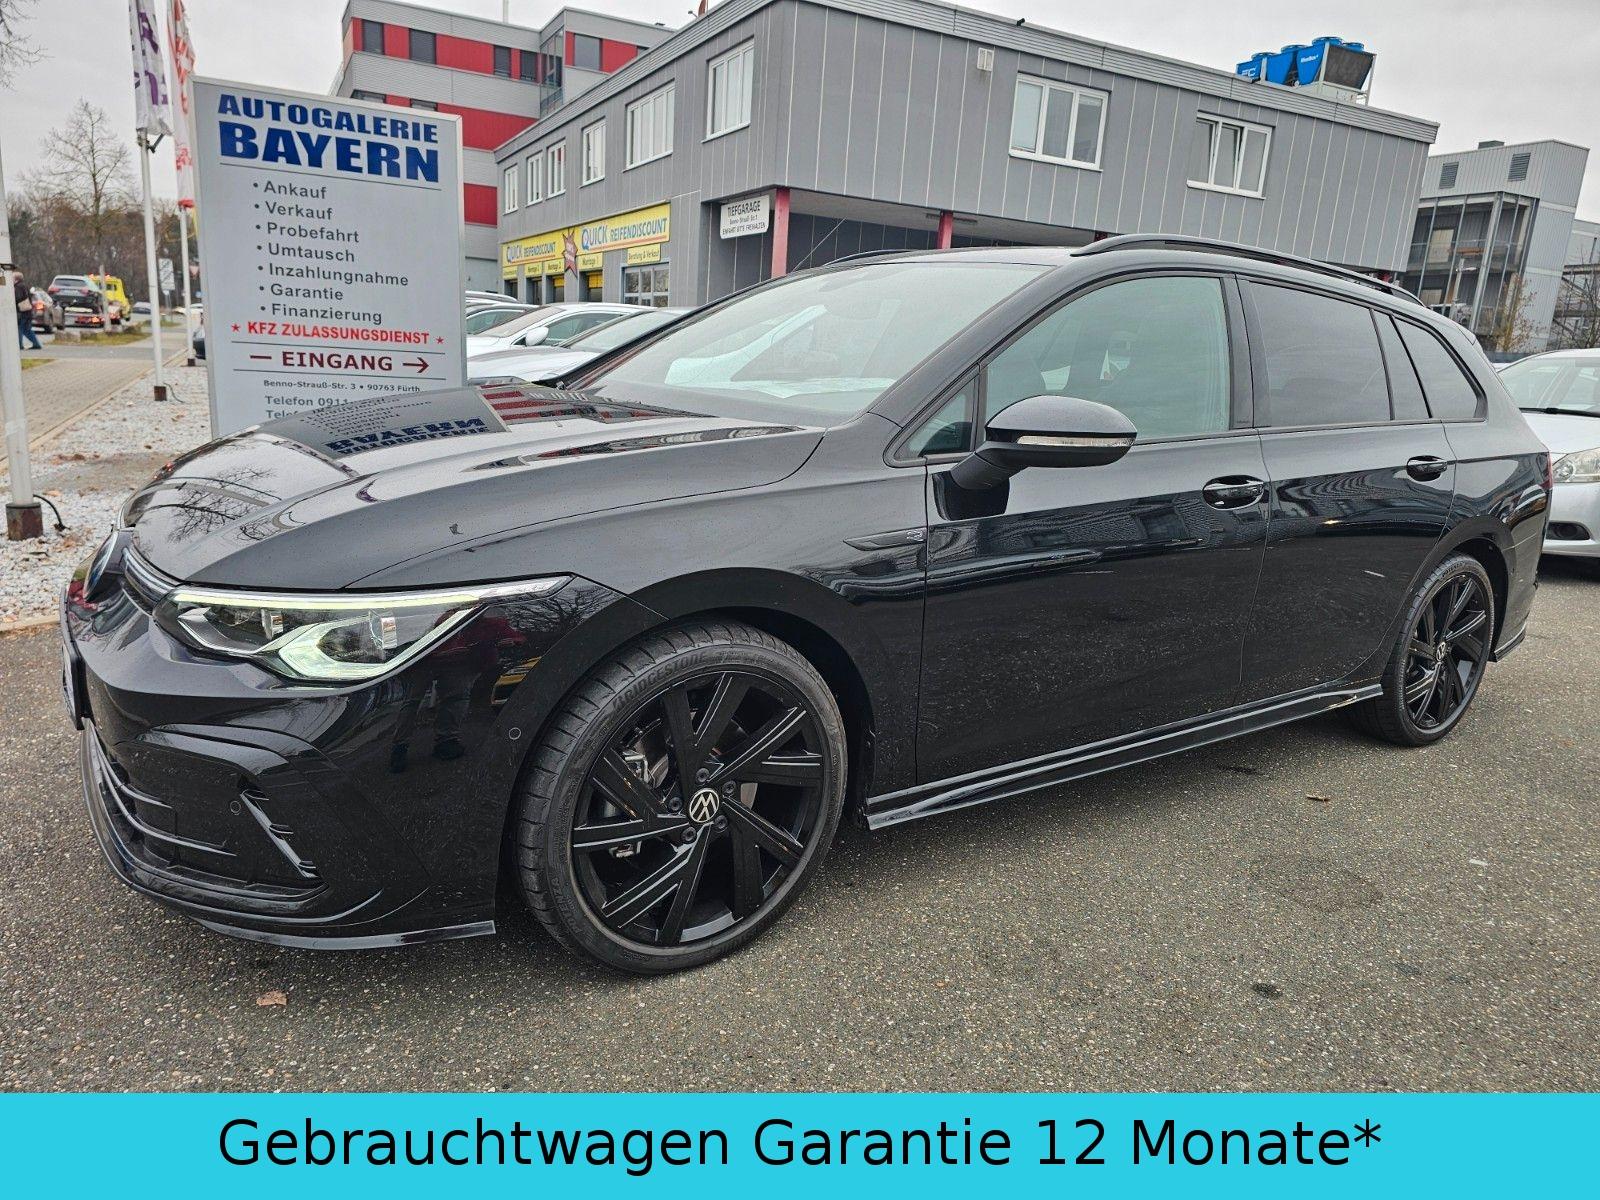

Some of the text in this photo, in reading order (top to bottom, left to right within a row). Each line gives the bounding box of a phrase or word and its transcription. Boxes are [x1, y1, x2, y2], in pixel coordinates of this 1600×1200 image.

[218, 94, 438, 144] AUTOGALERIE
[218, 120, 439, 183] BAYERN
[263, 180, 327, 200] Ankauf
[265, 201, 333, 221] Verkauf
[267, 222, 360, 243] Probefahrt
[581, 217, 668, 251] QUICK REIFENDISCOUNT
[268, 242, 355, 263] Umtausch
[269, 263, 409, 286] Inzahlungnahme
[270, 283, 343, 301] Garantie
[271, 303, 382, 326] Finanzierung
[247, 321, 430, 345] KFZ ZULASSUNGSDIENST
[282, 351, 393, 371] EINGANG
[263, 379, 348, 390] Benno-Strauß-Str.
[265, 395, 313, 406] Telefon
